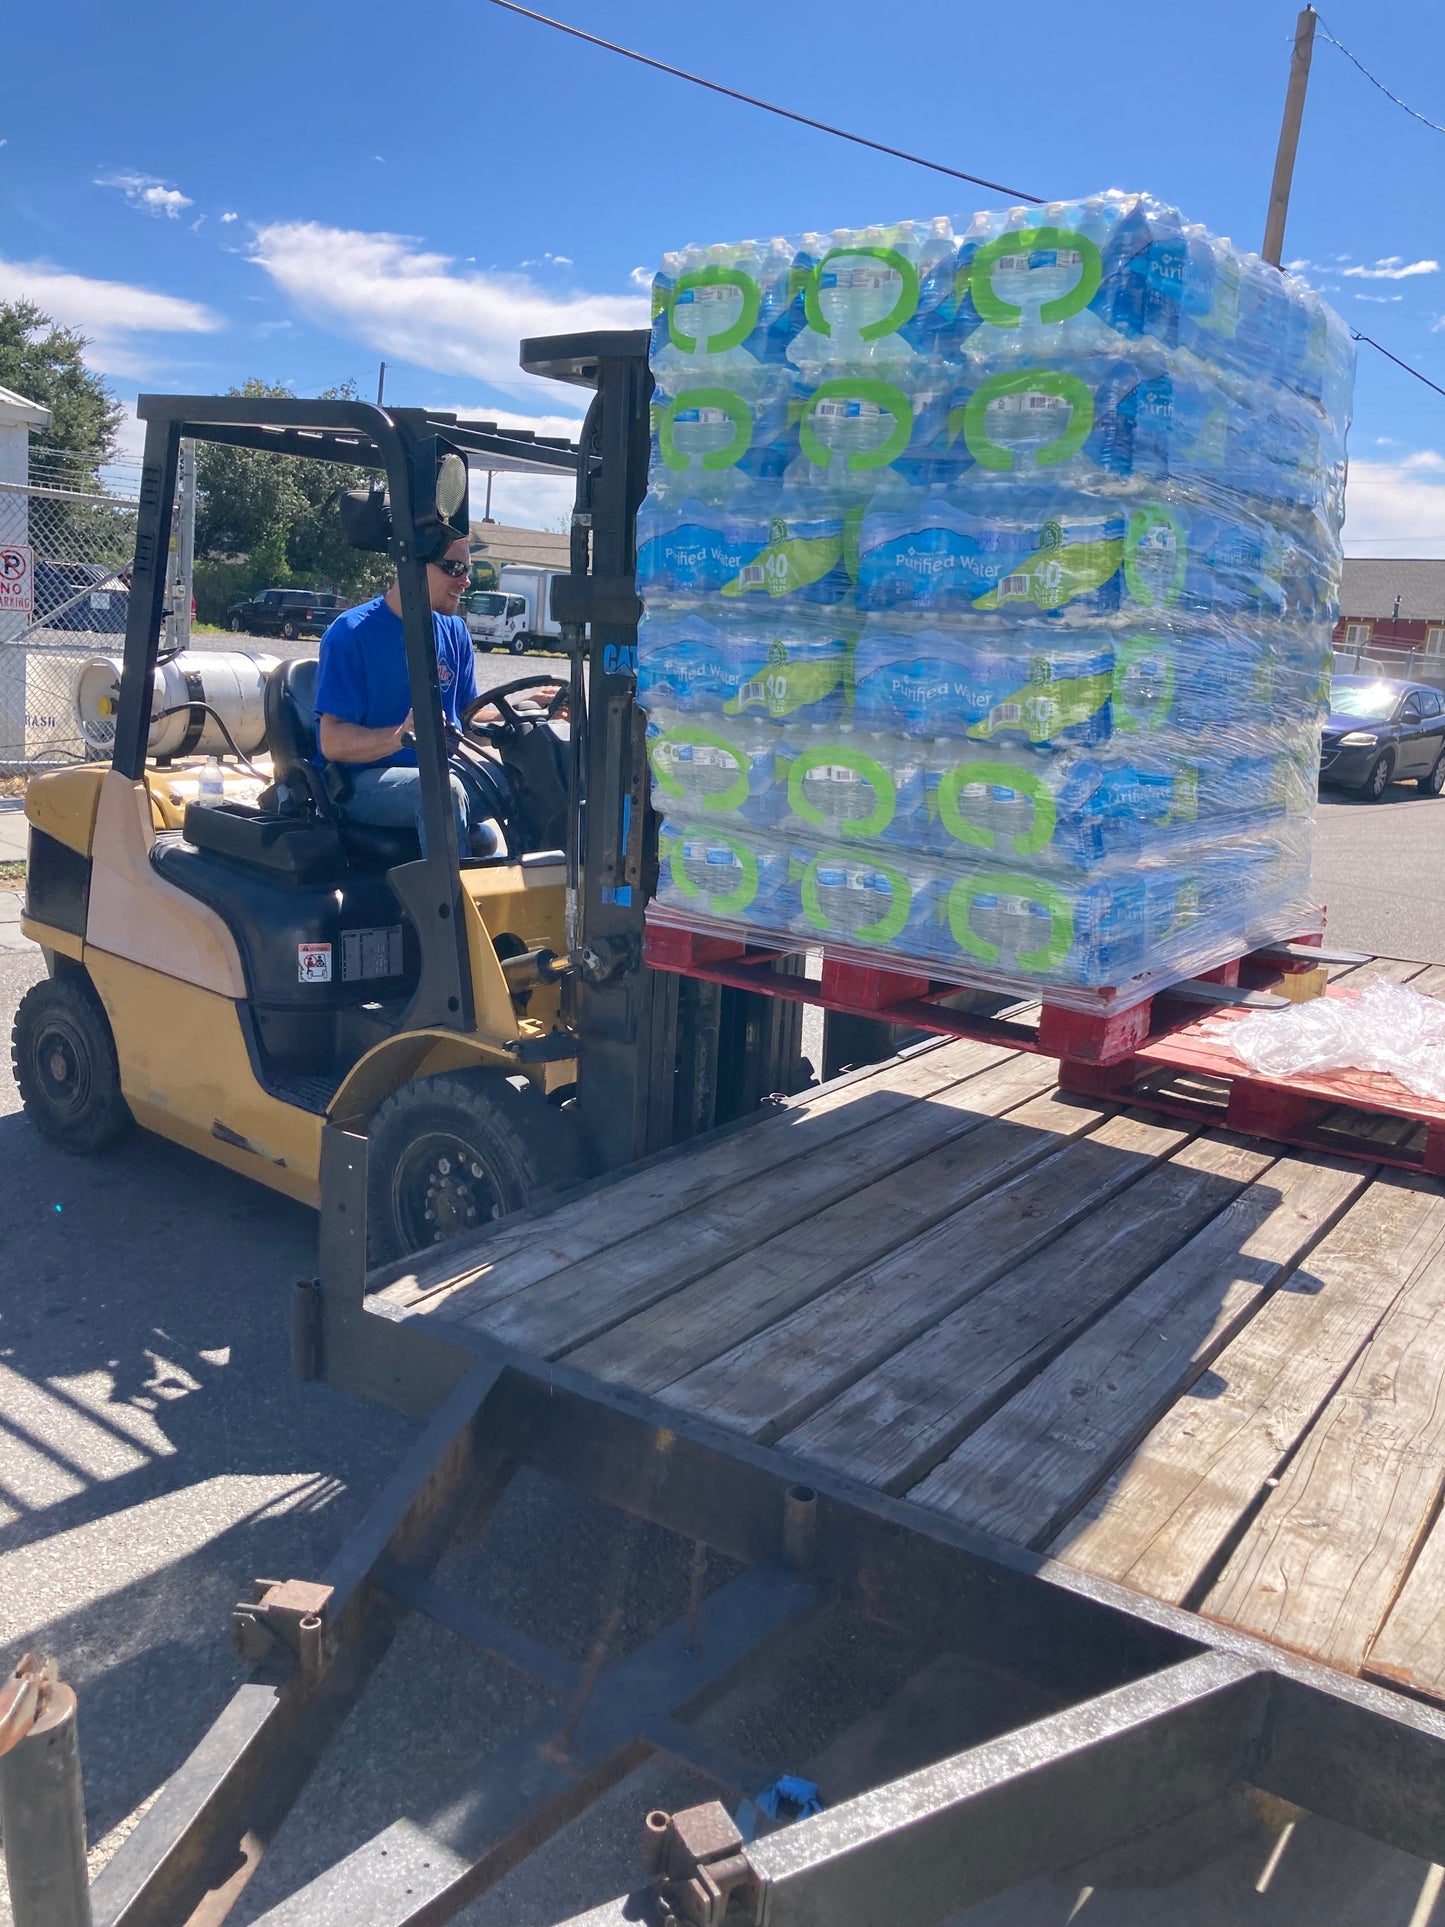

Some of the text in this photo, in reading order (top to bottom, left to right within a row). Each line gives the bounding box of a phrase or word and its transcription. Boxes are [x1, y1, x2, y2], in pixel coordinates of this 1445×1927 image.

[710, 548, 743, 568] Water
[765, 553, 788, 578] 40
[895, 554, 1002, 578] Purified Water
[1033, 560, 1061, 588] 40
[0, 582, 22, 595] NO
[0, 596, 30, 609] ARKING
[891, 679, 994, 708] Purified Water
[25, 715, 56, 728] RASH
